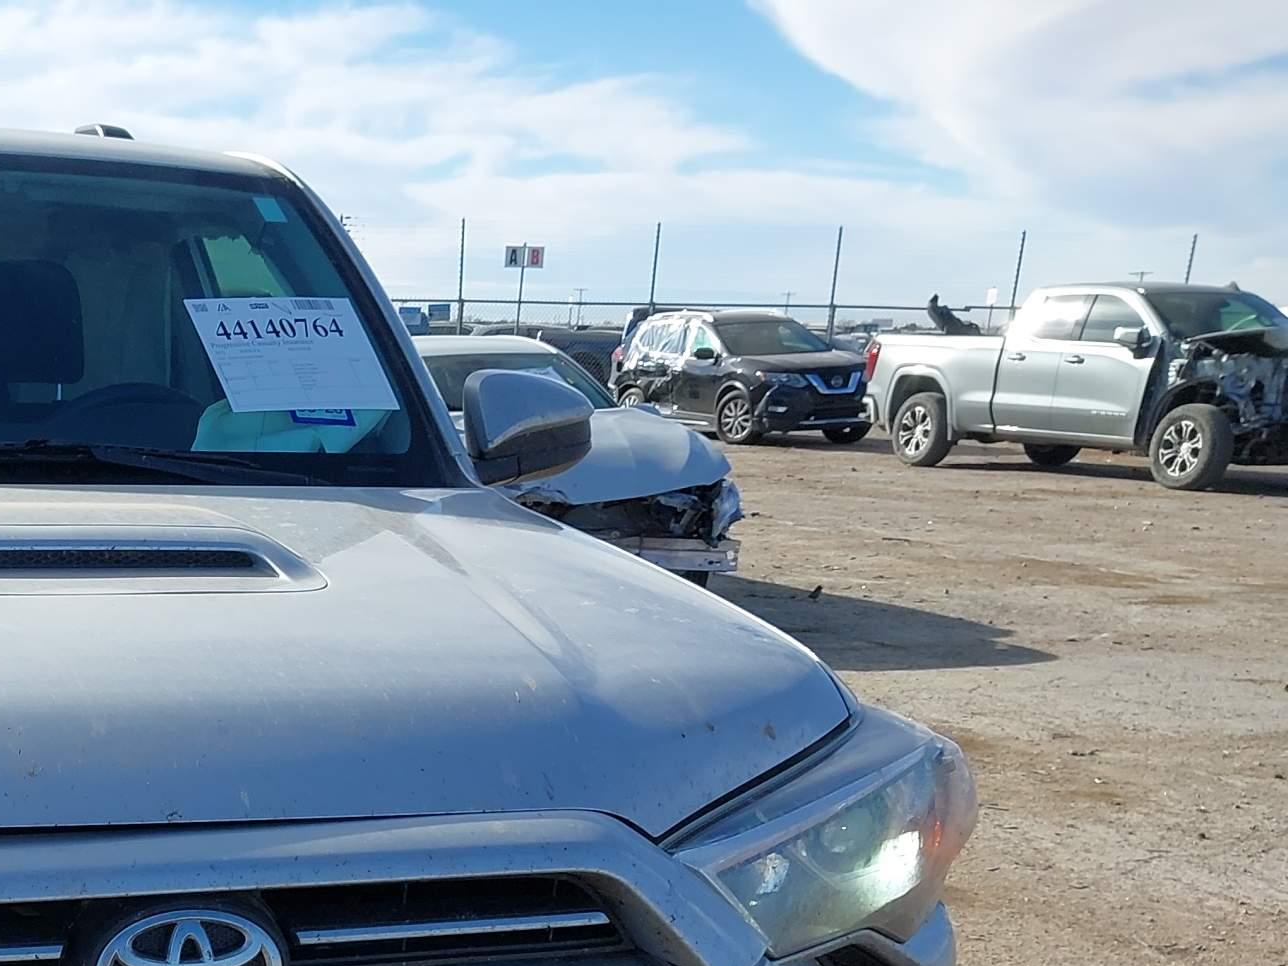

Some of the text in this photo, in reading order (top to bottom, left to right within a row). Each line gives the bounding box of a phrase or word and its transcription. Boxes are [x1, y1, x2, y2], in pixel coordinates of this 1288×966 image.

[509, 249, 518, 265] A
[531, 249, 540, 265] B
[215, 317, 344, 340] 44140764
